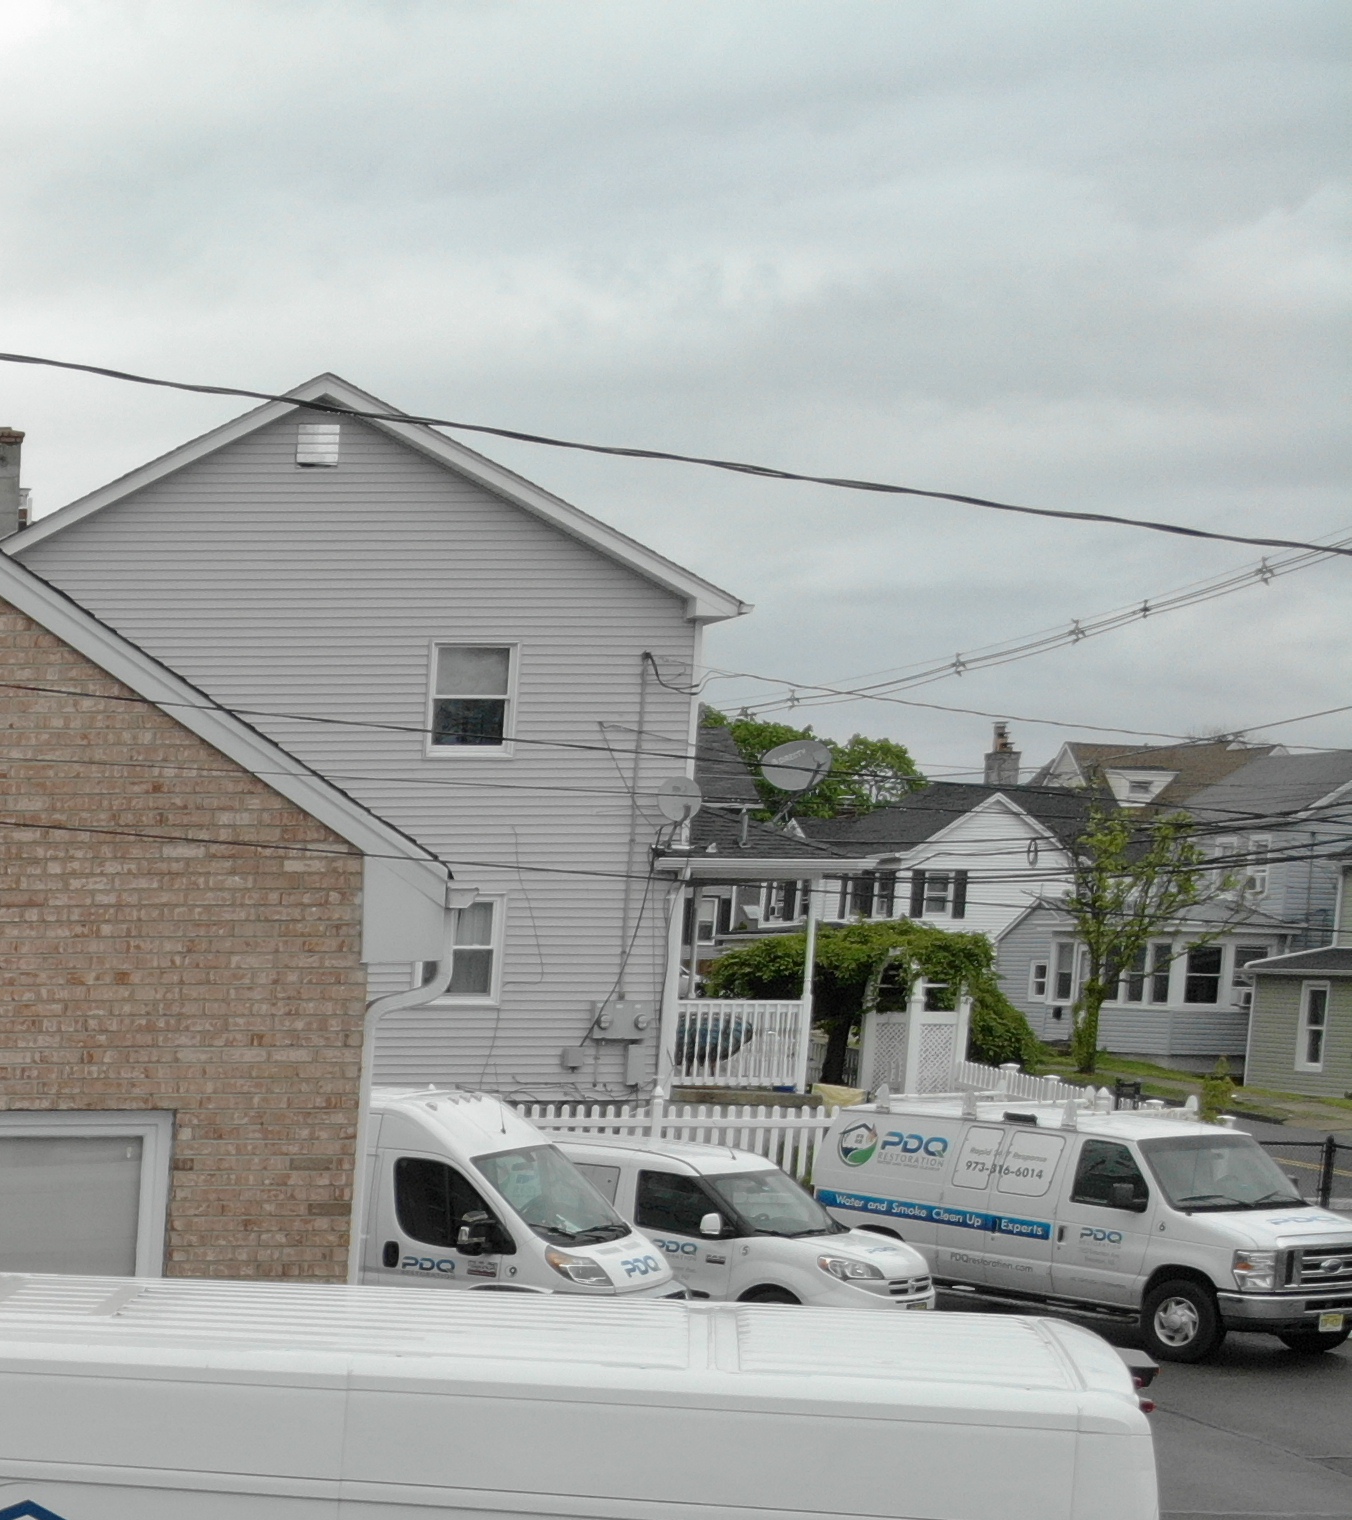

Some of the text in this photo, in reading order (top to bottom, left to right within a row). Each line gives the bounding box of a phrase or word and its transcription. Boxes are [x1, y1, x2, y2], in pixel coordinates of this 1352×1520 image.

[880, 1131, 949, 1158] PDQ
[877, 1151, 945, 1169] RESTORATION
[966, 1160, 1044, 1180] 973-316-6014
[836, 1193, 1044, 1236] Water and Smoke Clean Up Experts
[1080, 1227, 1123, 1245] PDQ
[1159, 1222, 1166, 1232] 6
[741, 1245, 749, 1256] 5
[402, 1256, 456, 1273] PDQ
[509, 1266, 518, 1277] 9
[621, 1255, 662, 1278] PDQ
